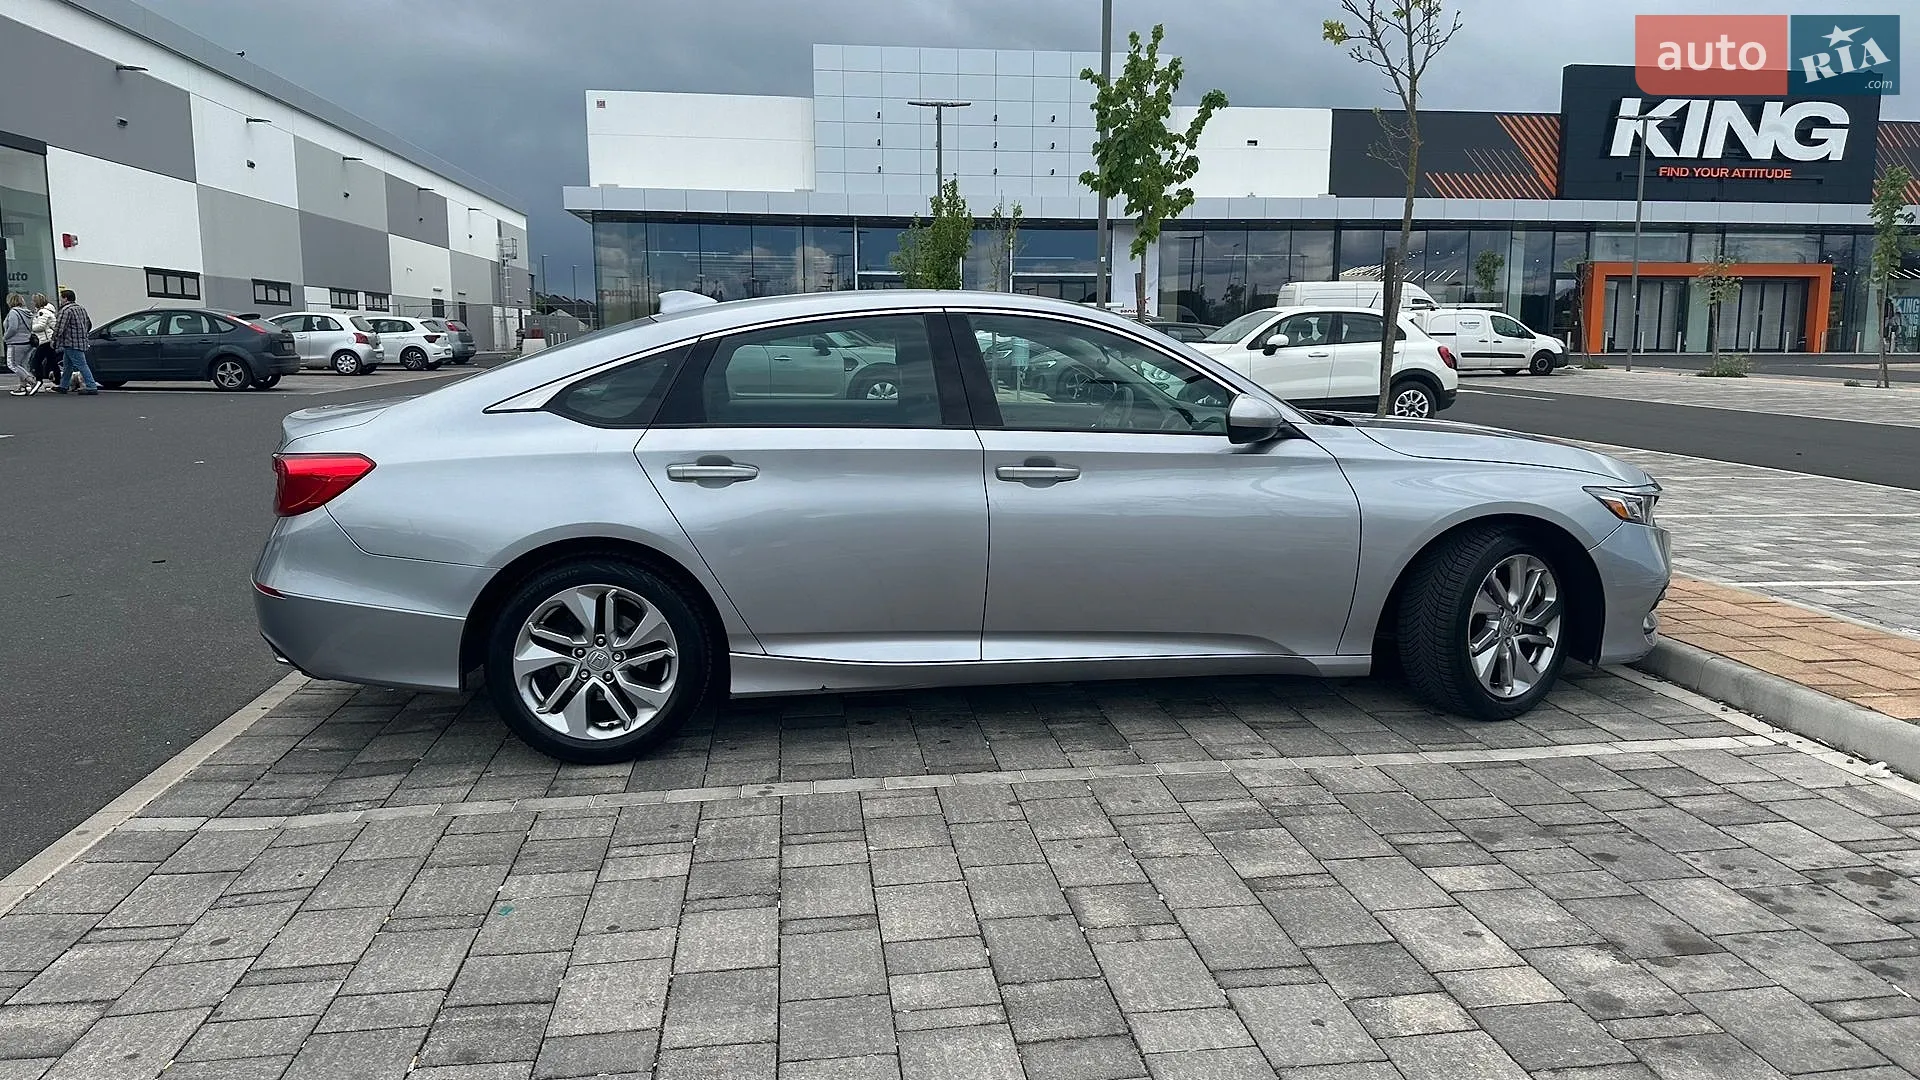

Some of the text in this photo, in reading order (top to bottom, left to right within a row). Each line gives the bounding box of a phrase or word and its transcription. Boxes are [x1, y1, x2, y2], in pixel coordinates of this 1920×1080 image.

[1609, 97, 1850, 162] KING
[1658, 166, 1793, 179] FIND YOUR ATTITUDE
